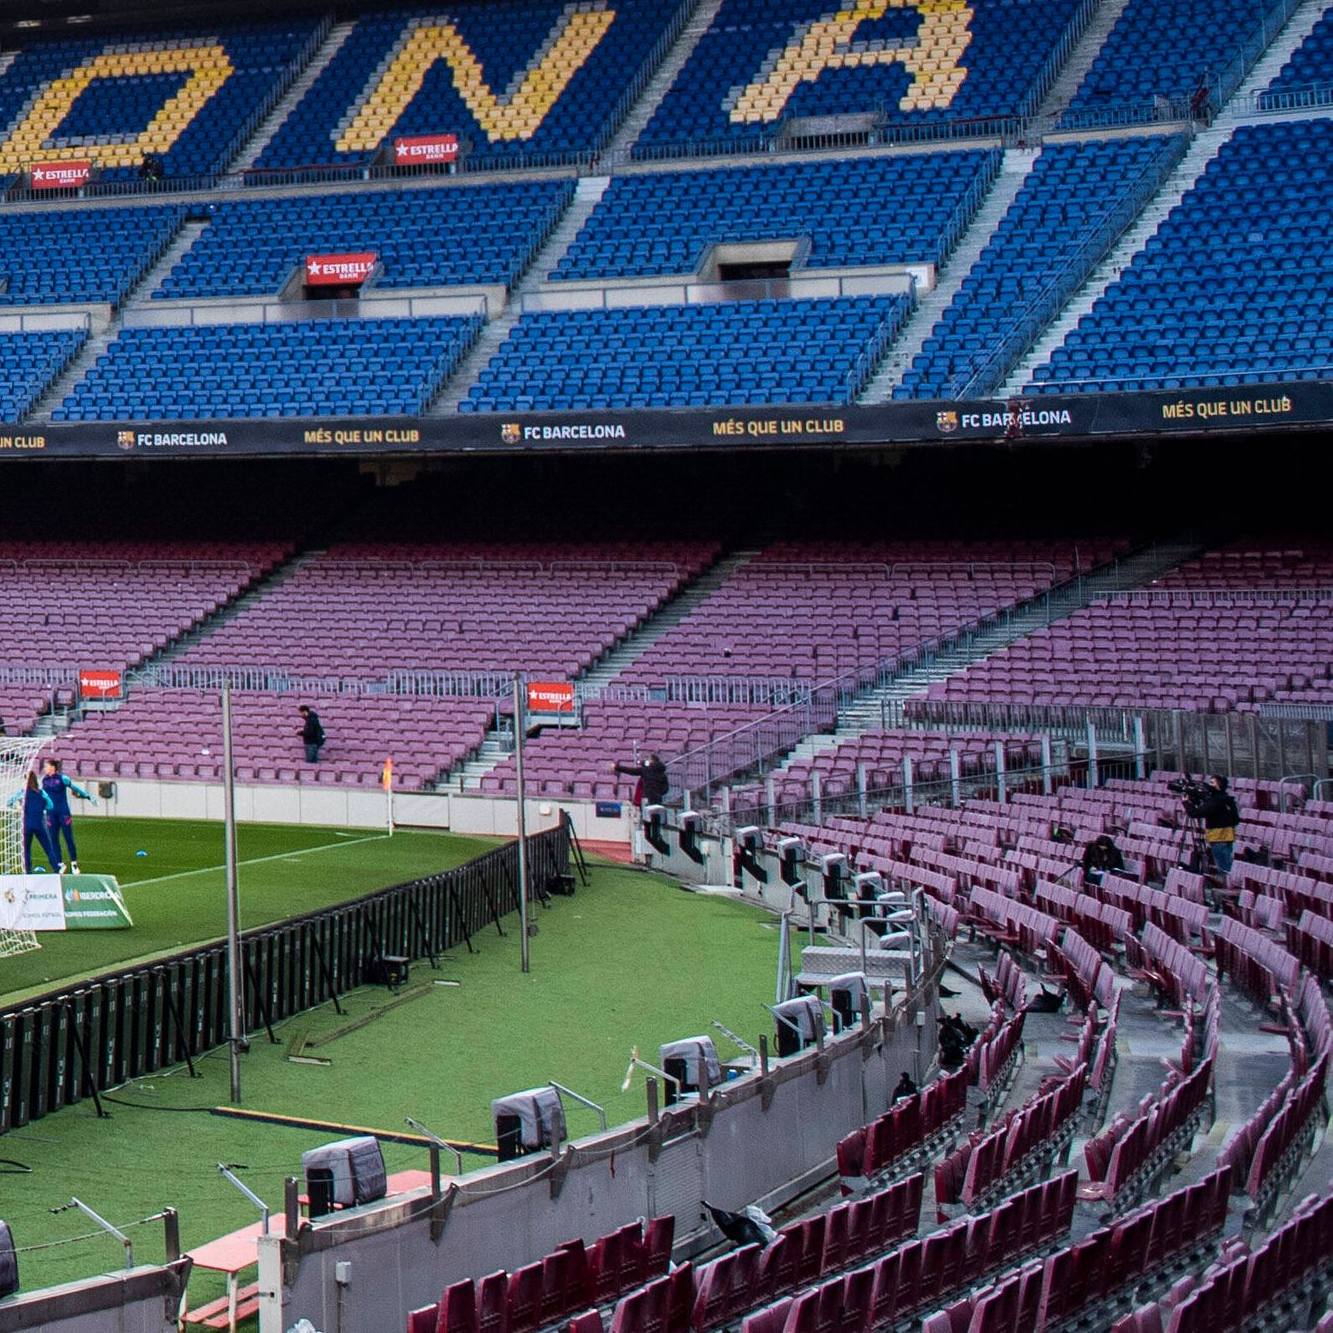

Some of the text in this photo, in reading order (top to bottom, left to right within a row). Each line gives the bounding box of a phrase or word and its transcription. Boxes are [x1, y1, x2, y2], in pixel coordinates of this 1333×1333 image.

[410, 143, 458, 155] ESTRELLA
[46, 168, 89, 179] ESTRELLA
[323, 262, 374, 274] ESTRELLA
[1163, 397, 1291, 419] MÉS QUE UN CLUB
[713, 419, 844, 435] MÉS QUE UN CLUB
[962, 414, 980, 428] FC
[305, 429, 419, 444] MÉS QUE UN CLUB
[525, 425, 624, 439] FC BARCELONA
[16, 437, 45, 448] CLUB
[138, 433, 227, 446] FC BARCELONA
[539, 692, 571, 700] ESTRELLA
[30, 892, 57, 900] PRIMERA
